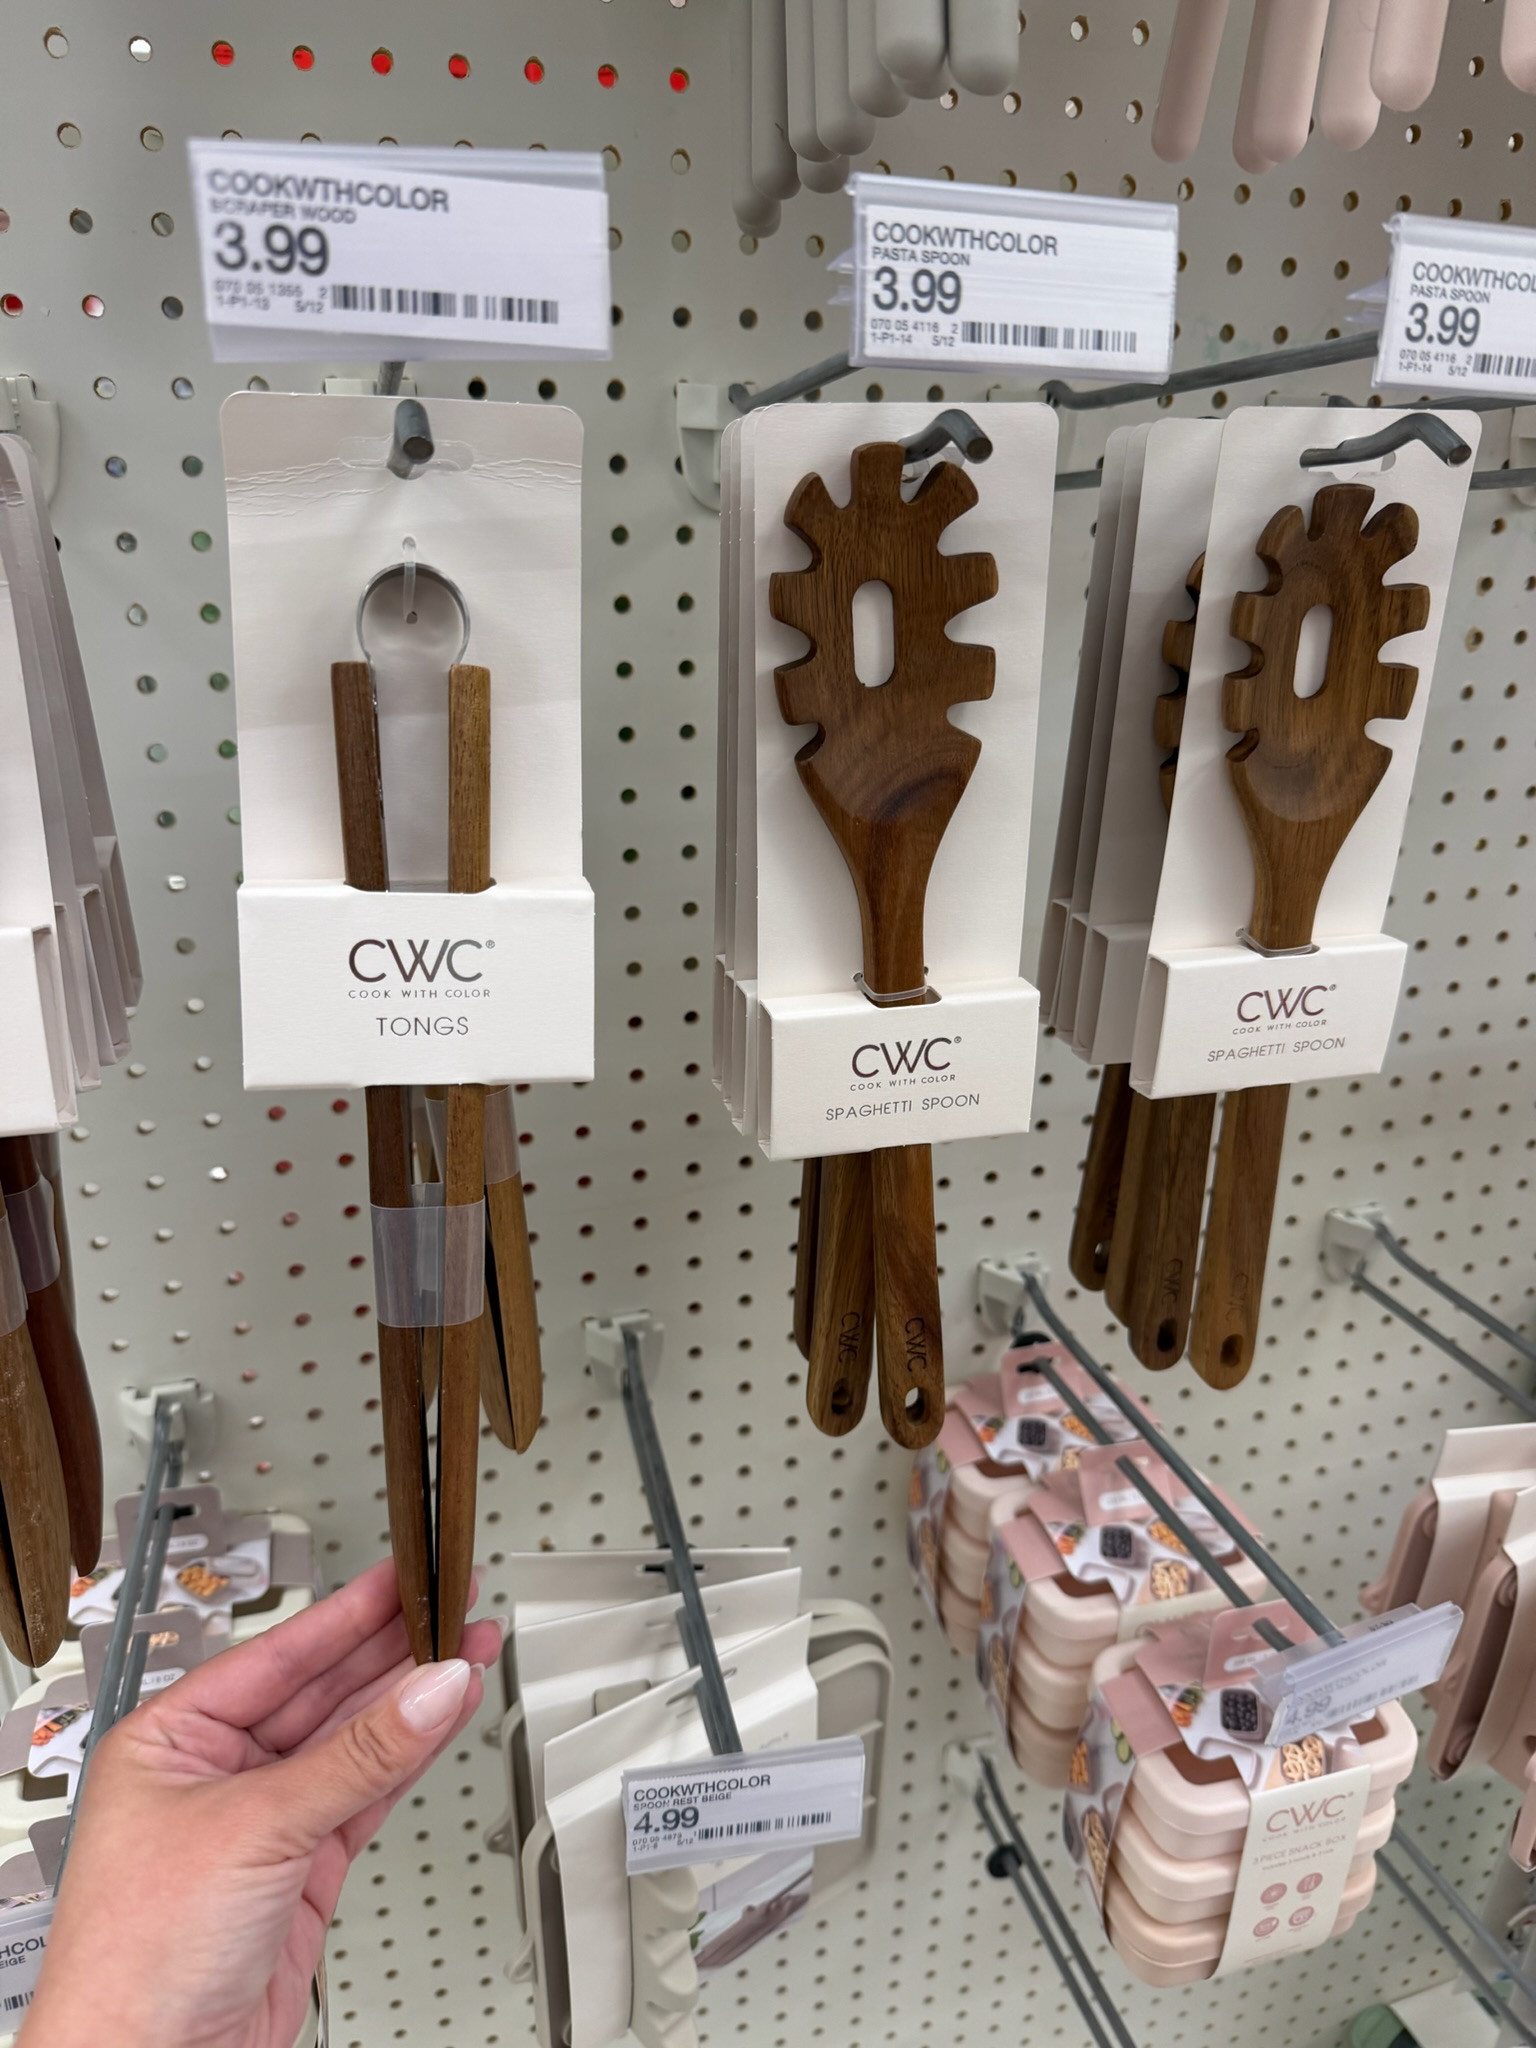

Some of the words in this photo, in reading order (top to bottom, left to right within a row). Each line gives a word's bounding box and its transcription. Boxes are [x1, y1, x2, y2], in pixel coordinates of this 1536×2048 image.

[208, 168, 450, 213] COOKWTHCOLOR
[210, 198, 296, 219] SCRAPER
[301, 206, 357, 224] WOOD
[213, 220, 330, 276] 3.99
[872, 221, 1058, 256] COOKWTHCOLOR
[872, 246, 917, 263] PASTA
[921, 250, 970, 267] SPOON
[872, 266, 962, 315] 3.99
[1409, 283, 1448, 300] PASTA
[1450, 287, 1491, 304] SPOON
[870, 318, 891, 331] 070
[895, 319, 909, 332] 05
[951, 323, 959, 335] 2
[1405, 302, 1481, 348] 3.99
[870, 332, 913, 344] 1-P1-14
[932, 335, 955, 347] 5/12
[1399, 349, 1417, 362] 070
[1419, 350, 1431, 363] 05
[1466, 354, 1473, 366] 2
[1448, 365, 1468, 377] 5/12
[348, 989, 392, 999] COOK
[401, 989, 438, 999] WITH
[445, 989, 491, 999] COLOR
[376, 1016, 469, 1037] TONGS
[1232, 1026, 1261, 1035] COOK
[1267, 1023, 1292, 1031] WITH
[1295, 1019, 1328, 1028] COLOR
[1207, 1042, 1286, 1063] SPAGHETTI
[1292, 1037, 1346, 1053] SPOON
[850, 1081, 882, 1092] COOK
[889, 1078, 916, 1087] WITH
[921, 1074, 956, 1084] COLOR
[825, 1100, 912, 1121] SPAGHETTI
[921, 1093, 980, 1111] SPOON
[838, 1311, 861, 1363] CWC
[904, 1317, 927, 1373] CWC
[633, 1774, 771, 1802] COOKWTHCOLOR
[633, 1799, 670, 1812] SPOON
[672, 1796, 699, 1806] REST
[701, 1792, 732, 1803] BEIGE
[633, 1806, 700, 1834] 4.99
[632, 1838, 647, 1846] 070
[650, 1836, 660, 1844] 05
[1288, 1841, 1322, 1856] SNACK
